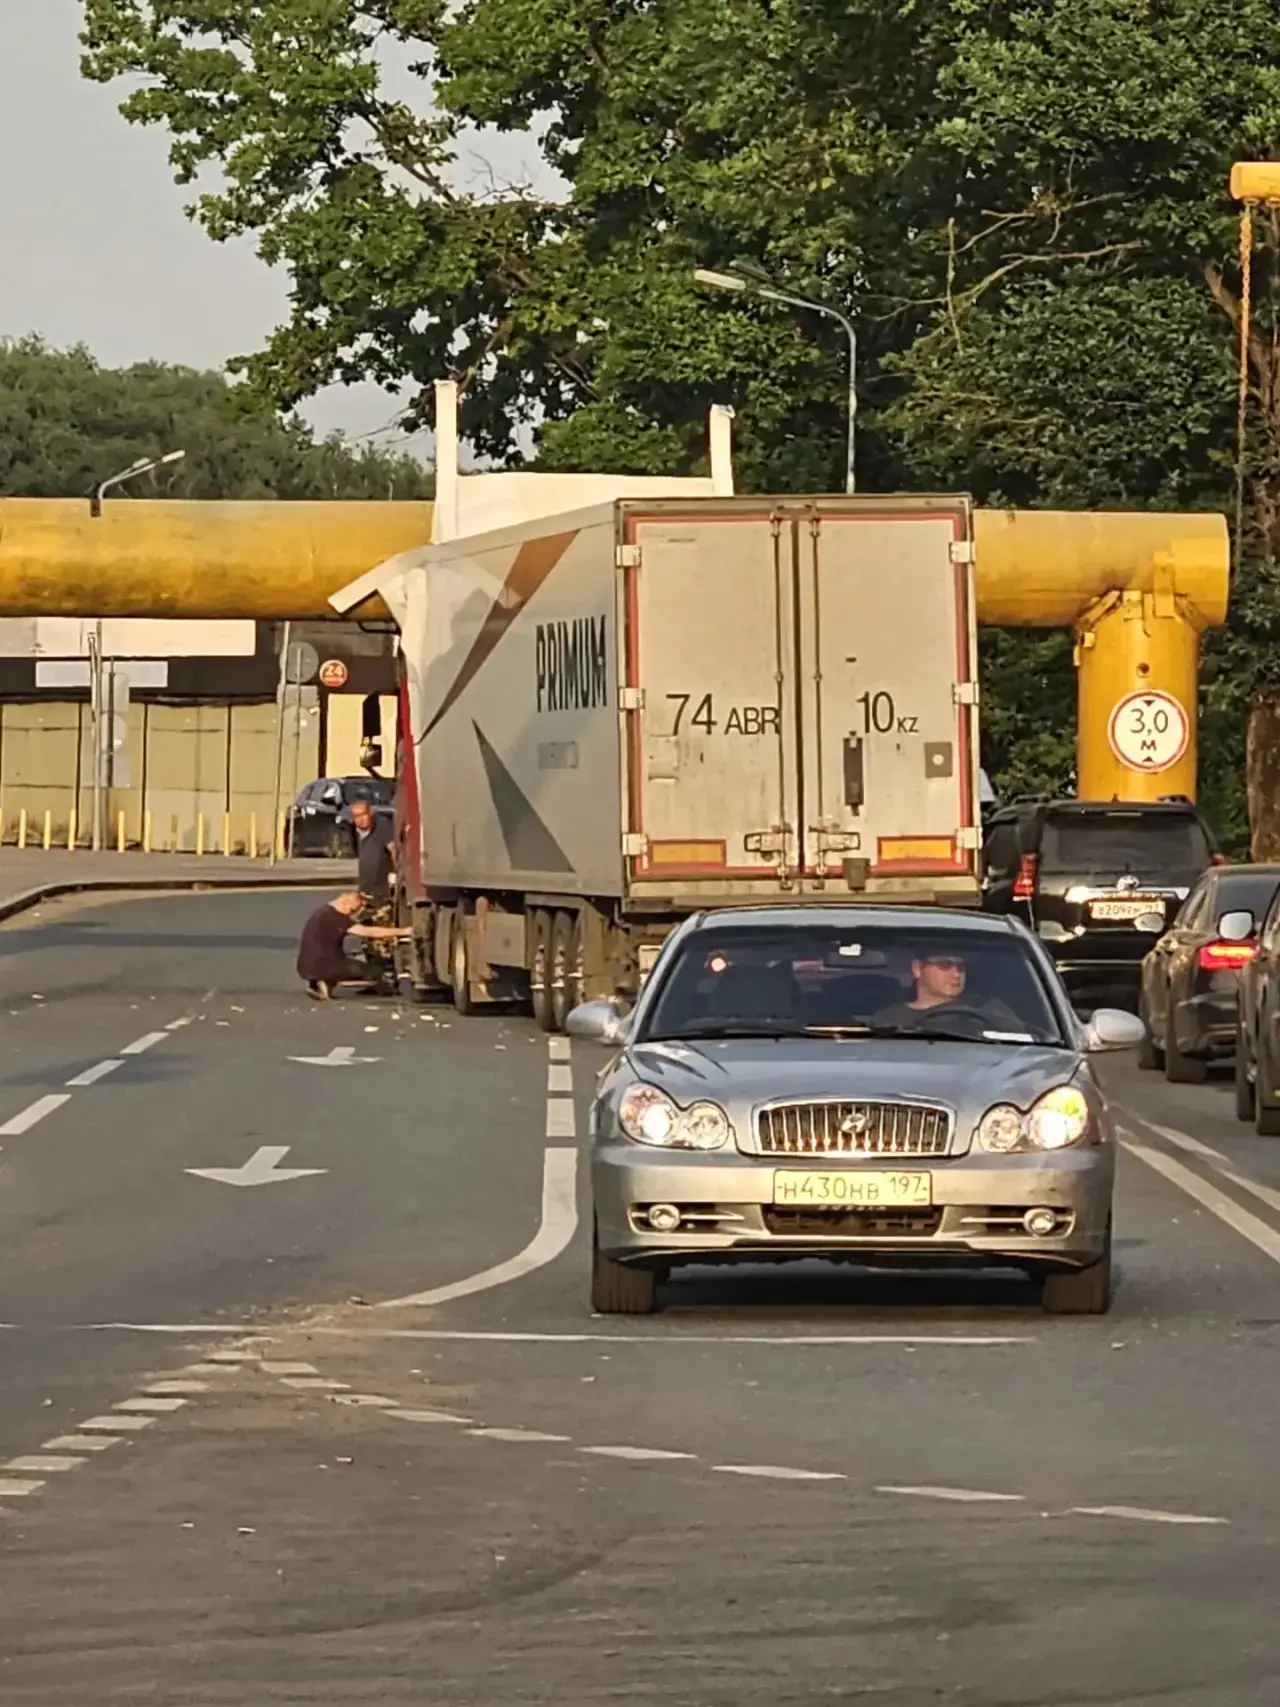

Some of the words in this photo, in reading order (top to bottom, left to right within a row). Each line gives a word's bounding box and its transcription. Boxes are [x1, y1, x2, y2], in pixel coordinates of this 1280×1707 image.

[536, 614, 607, 713] PRIMUM
[666, 693, 717, 736] 74
[724, 706, 781, 736] ABR
[1130, 707, 1169, 736] 3,0
